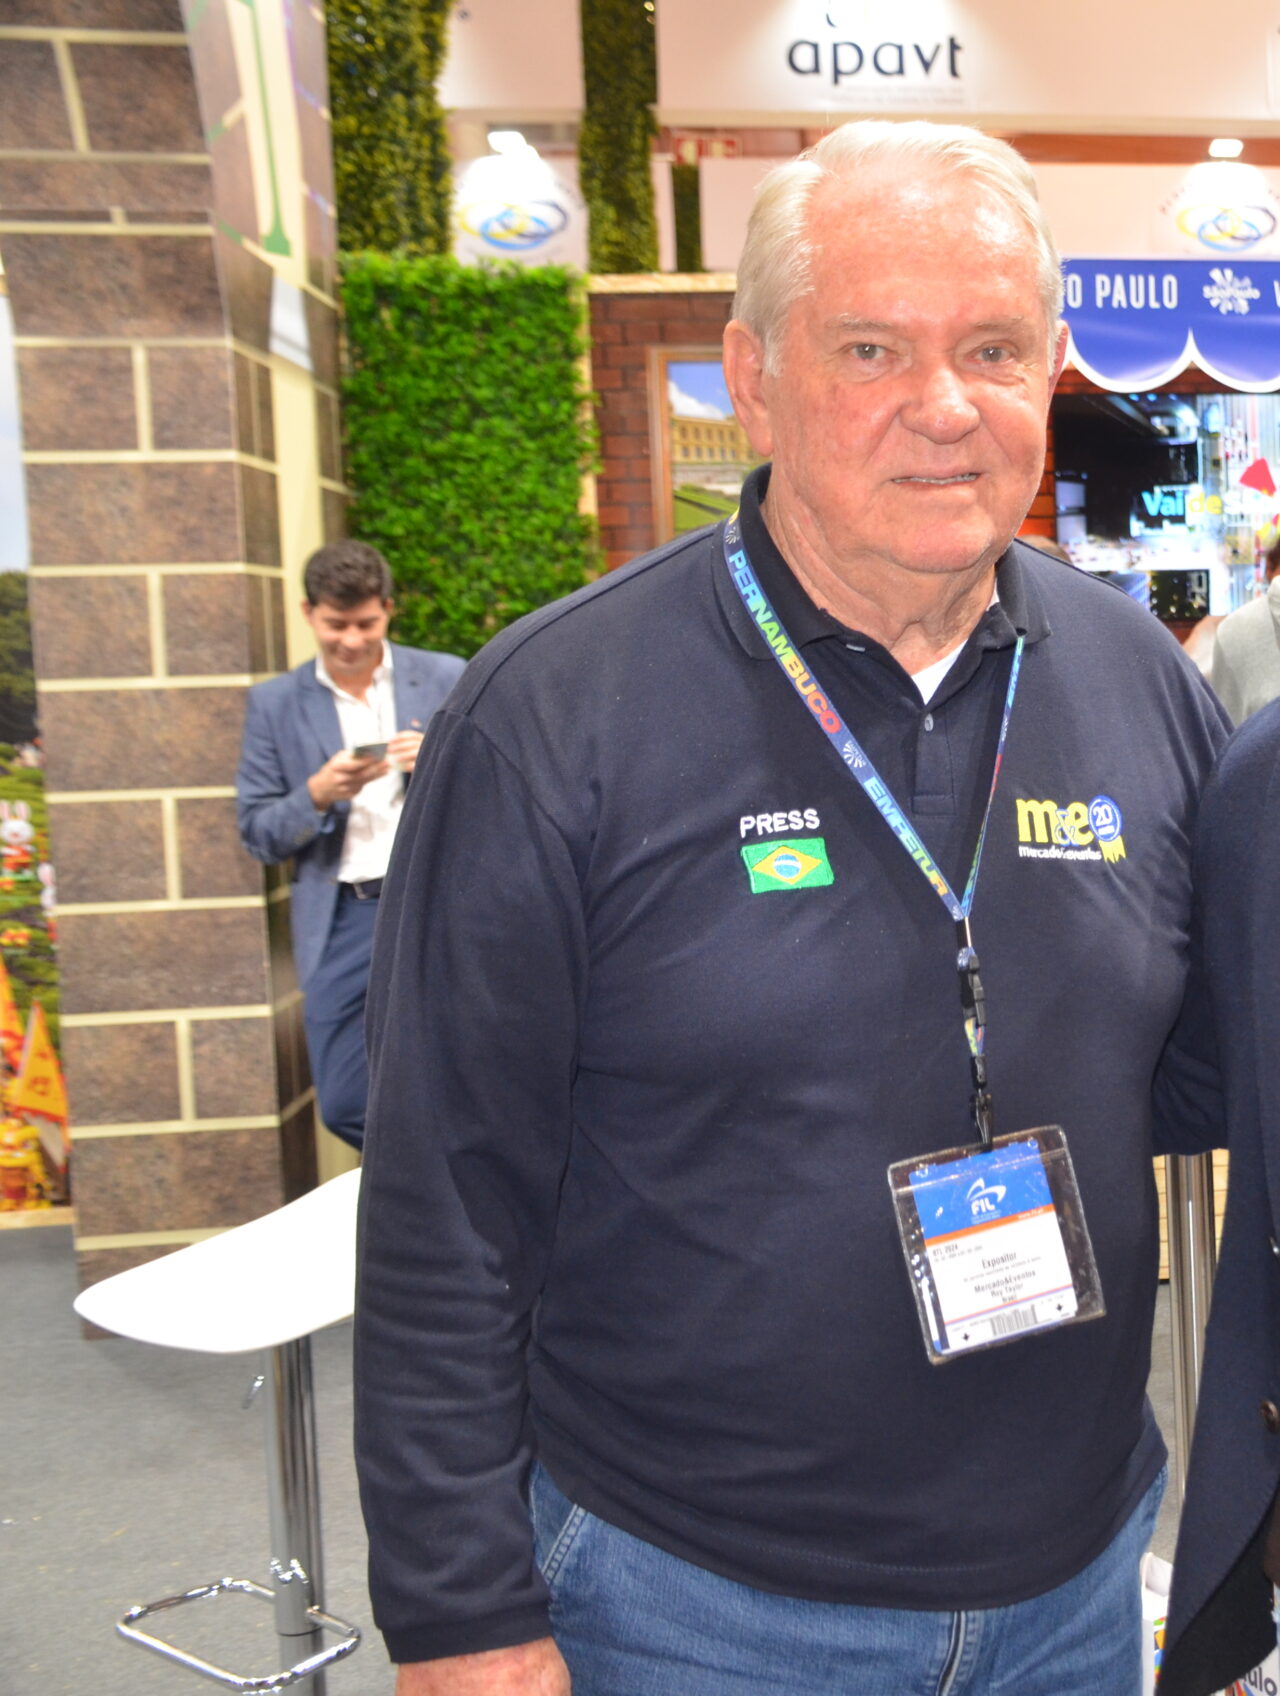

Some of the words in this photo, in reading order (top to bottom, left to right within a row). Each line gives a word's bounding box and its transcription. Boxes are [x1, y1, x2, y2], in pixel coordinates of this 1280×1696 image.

[786, 36, 963, 86] apavt
[1095, 273, 1179, 310] PAULO
[728, 549, 842, 735] PERNAMBUCO
[740, 808, 820, 838] PRESS
[863, 776, 949, 897] EMPETUR
[971, 1197, 996, 1216] FIL
